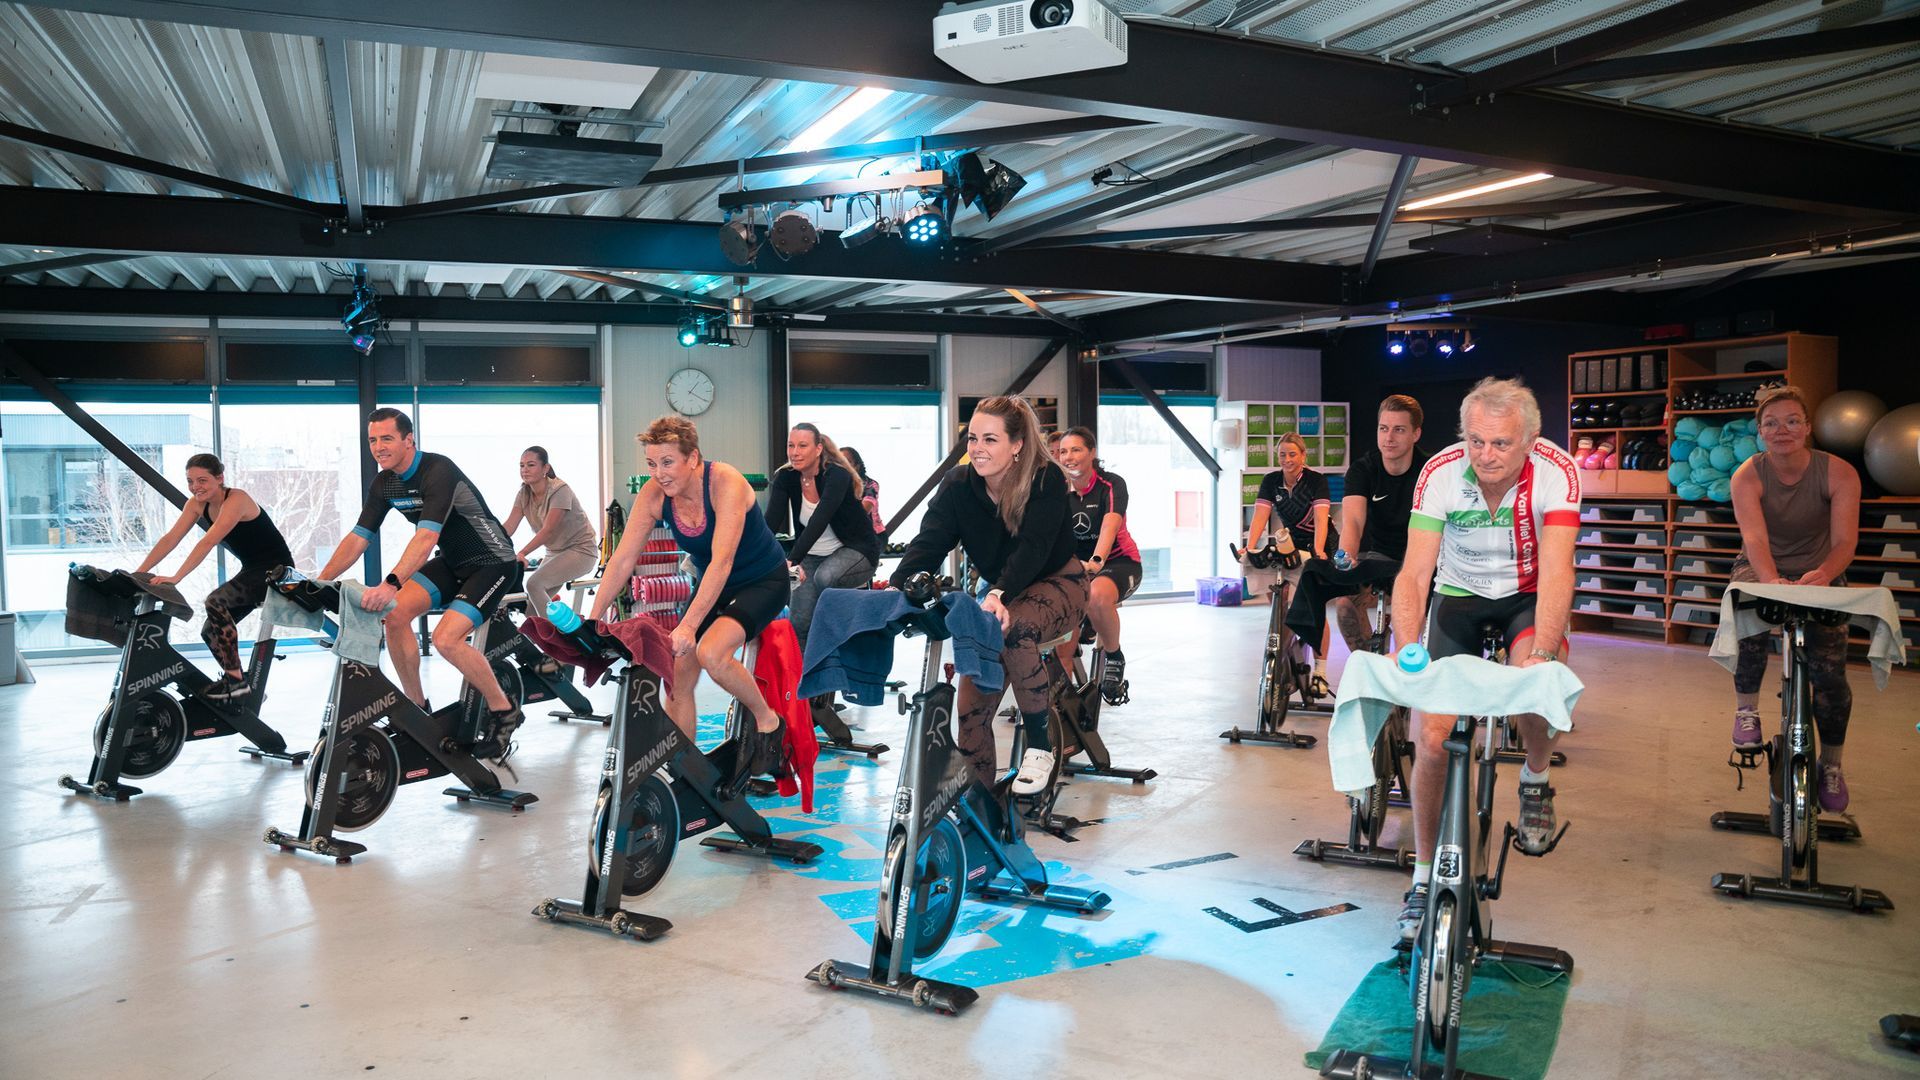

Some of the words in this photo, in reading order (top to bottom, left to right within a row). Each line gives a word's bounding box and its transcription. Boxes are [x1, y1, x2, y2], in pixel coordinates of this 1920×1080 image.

[1535, 443, 1552, 456] Van
[1553, 450, 1568, 468] Vliet
[1518, 491, 1528, 516] Van
[1519, 518, 1530, 541] Vliet
[128, 661, 185, 696] SPINNING
[340, 691, 397, 735] SPINNING
[101, 727, 114, 759] SPINNING
[627, 730, 679, 785] SPINNING
[314, 772, 327, 811] SPINNING
[923, 765, 968, 828] SPINNING
[1523, 787, 1541, 795] SIDI
[1783, 803, 1791, 847] SPINNING
[601, 829, 615, 876] SPINNING
[895, 885, 911, 940] SPINNING
[1416, 957, 1429, 1023] SPINNING
[1450, 962, 1465, 1029] SPINNING
